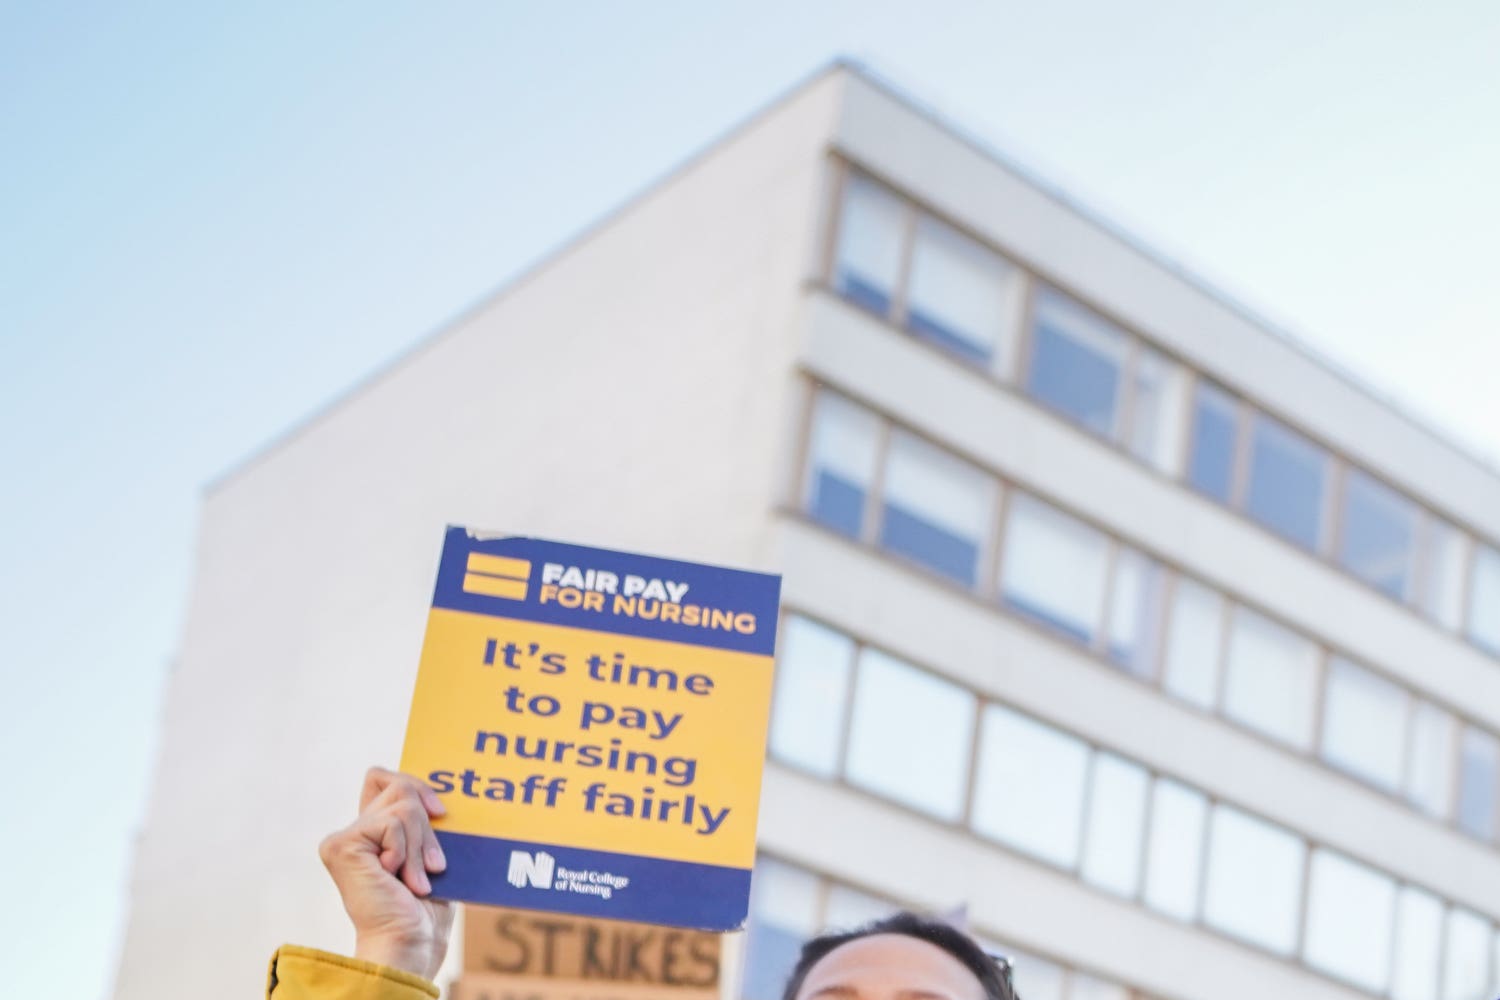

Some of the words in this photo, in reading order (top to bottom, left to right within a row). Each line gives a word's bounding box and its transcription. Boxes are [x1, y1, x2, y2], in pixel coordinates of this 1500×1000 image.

[539, 584, 604, 613] FOR
[612, 597, 757, 635] NURSING
[542, 562, 618, 595] FAIR
[624, 574, 690, 604] PAY
[483, 637, 567, 676] It’s
[585, 652, 715, 696] time
[503, 686, 562, 719] to
[580, 701, 684, 740] pay
[473, 729, 698, 787] nursing
[427, 768, 569, 809] staff
[582, 782, 732, 836] fairly
[555, 880, 568, 891] of
[569, 881, 613, 900] Nursing
[557, 866, 588, 883] Royal
[588, 871, 630, 890] College
[485, 912, 721, 988] STRIKES
